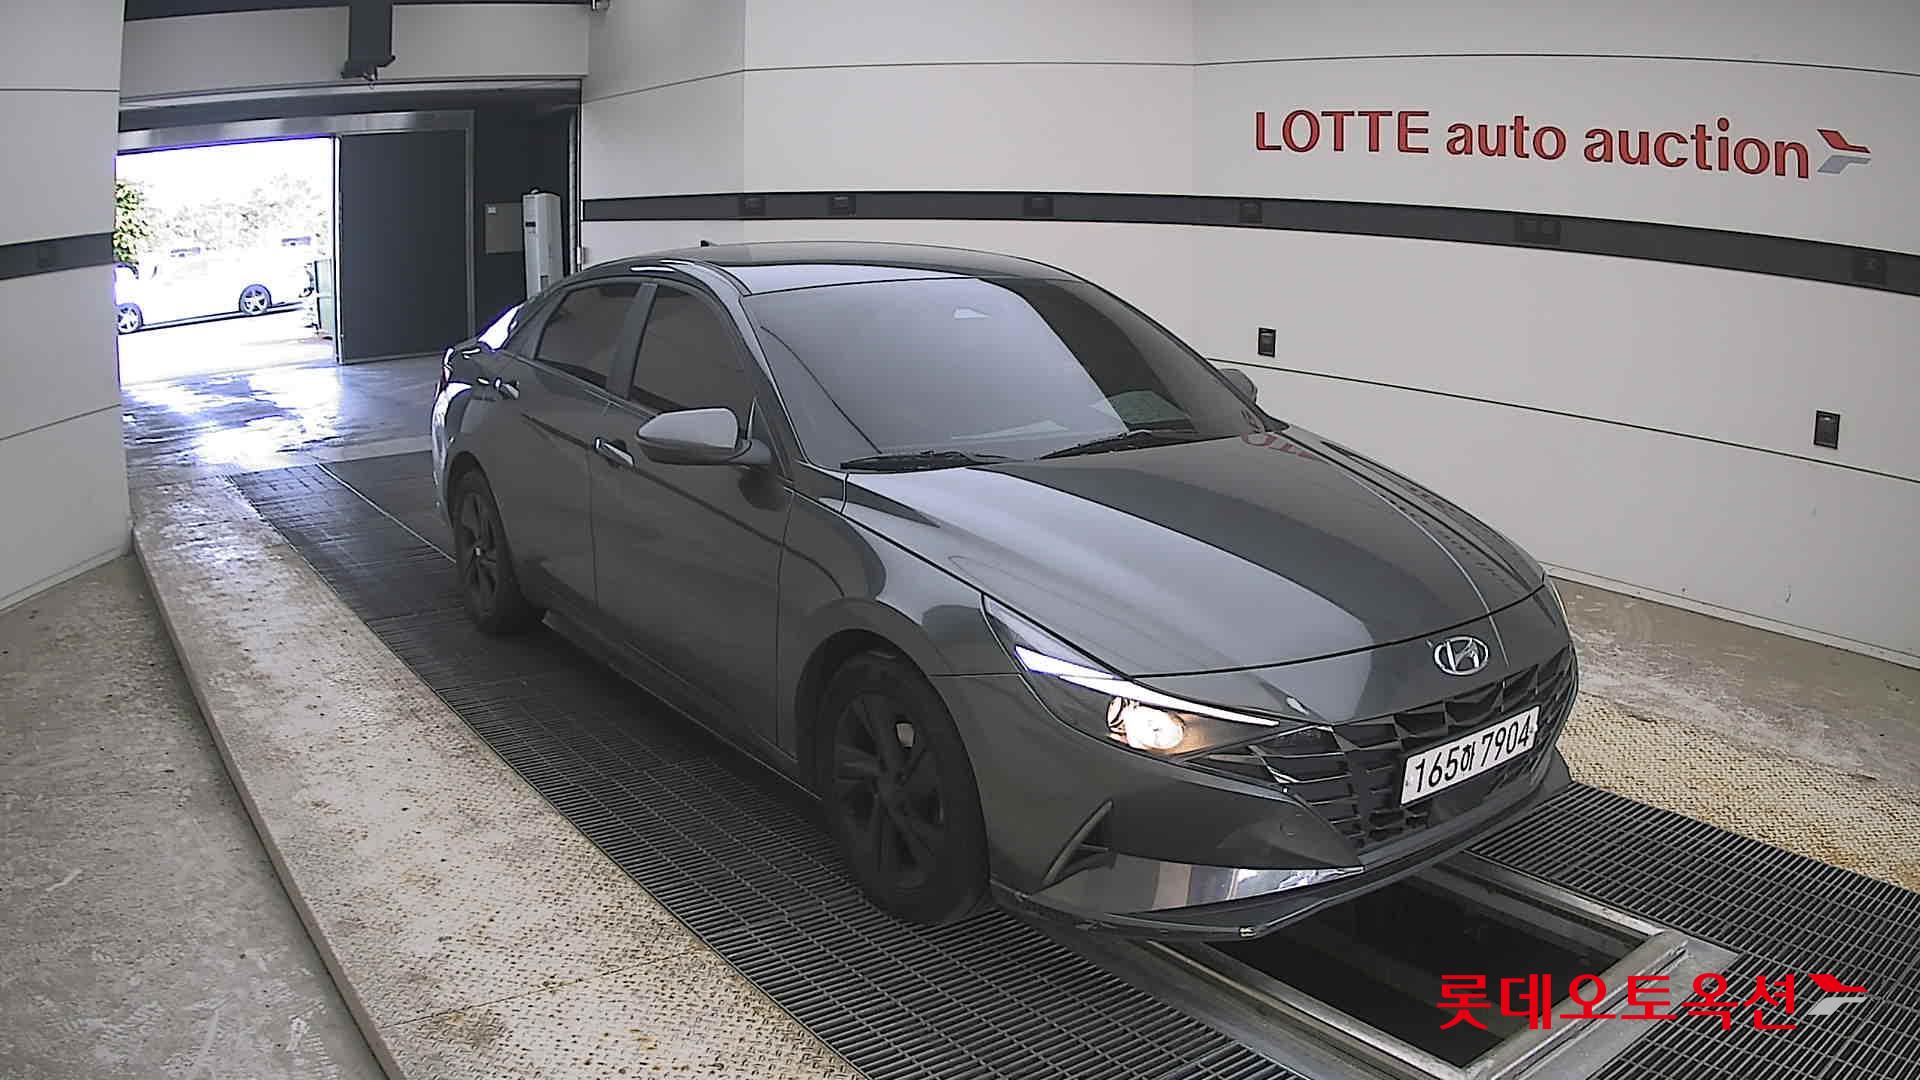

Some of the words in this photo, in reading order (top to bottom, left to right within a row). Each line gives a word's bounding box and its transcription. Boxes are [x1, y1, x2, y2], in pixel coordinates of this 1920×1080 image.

[1256, 110, 1430, 153] LOTTE
[1446, 116, 1567, 160] auto
[1584, 118, 1809, 178] auction
